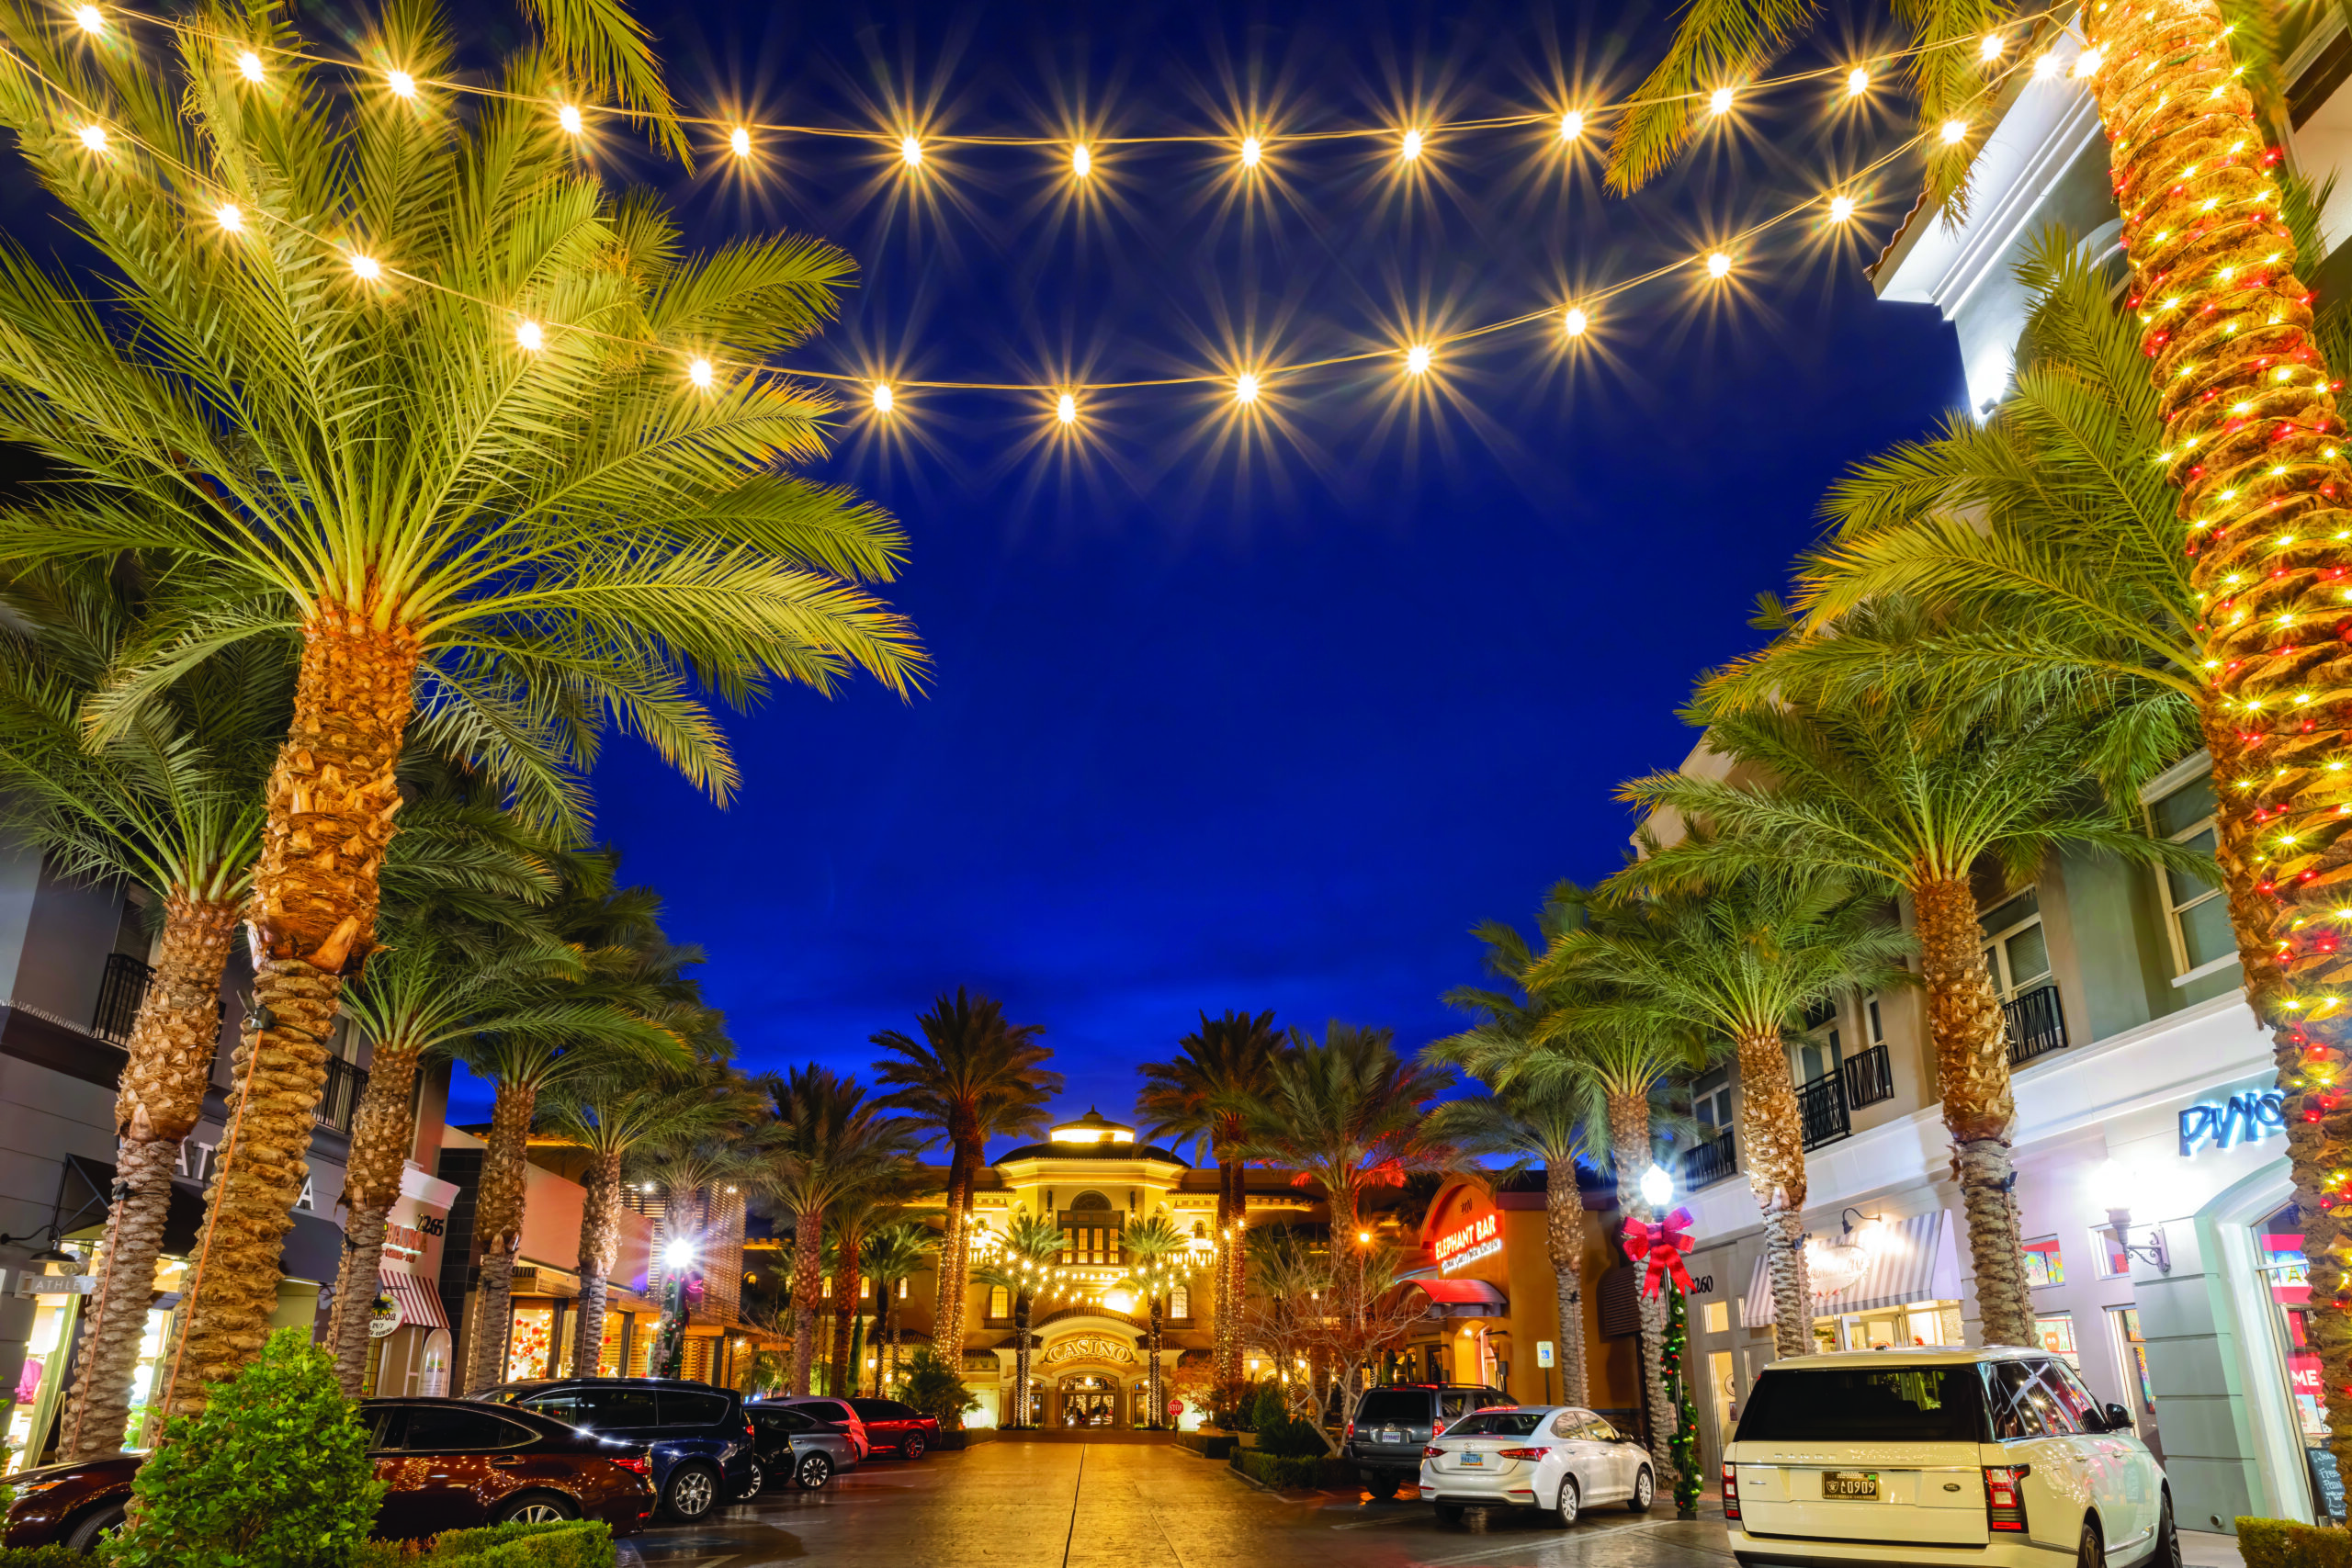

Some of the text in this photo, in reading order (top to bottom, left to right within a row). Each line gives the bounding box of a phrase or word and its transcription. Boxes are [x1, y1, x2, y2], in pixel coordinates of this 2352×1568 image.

[416, 1213, 444, 1236] 2265
[386, 1223, 427, 1254] BALBOA
[1435, 1214, 1496, 1260] ELEPHANT BAR
[35, 1280, 96, 1291] ATHLET
[370, 1311, 396, 1321] alboa
[1050, 1339, 1128, 1362] CASINO
[1169, 1404, 1182, 1412] STOP
